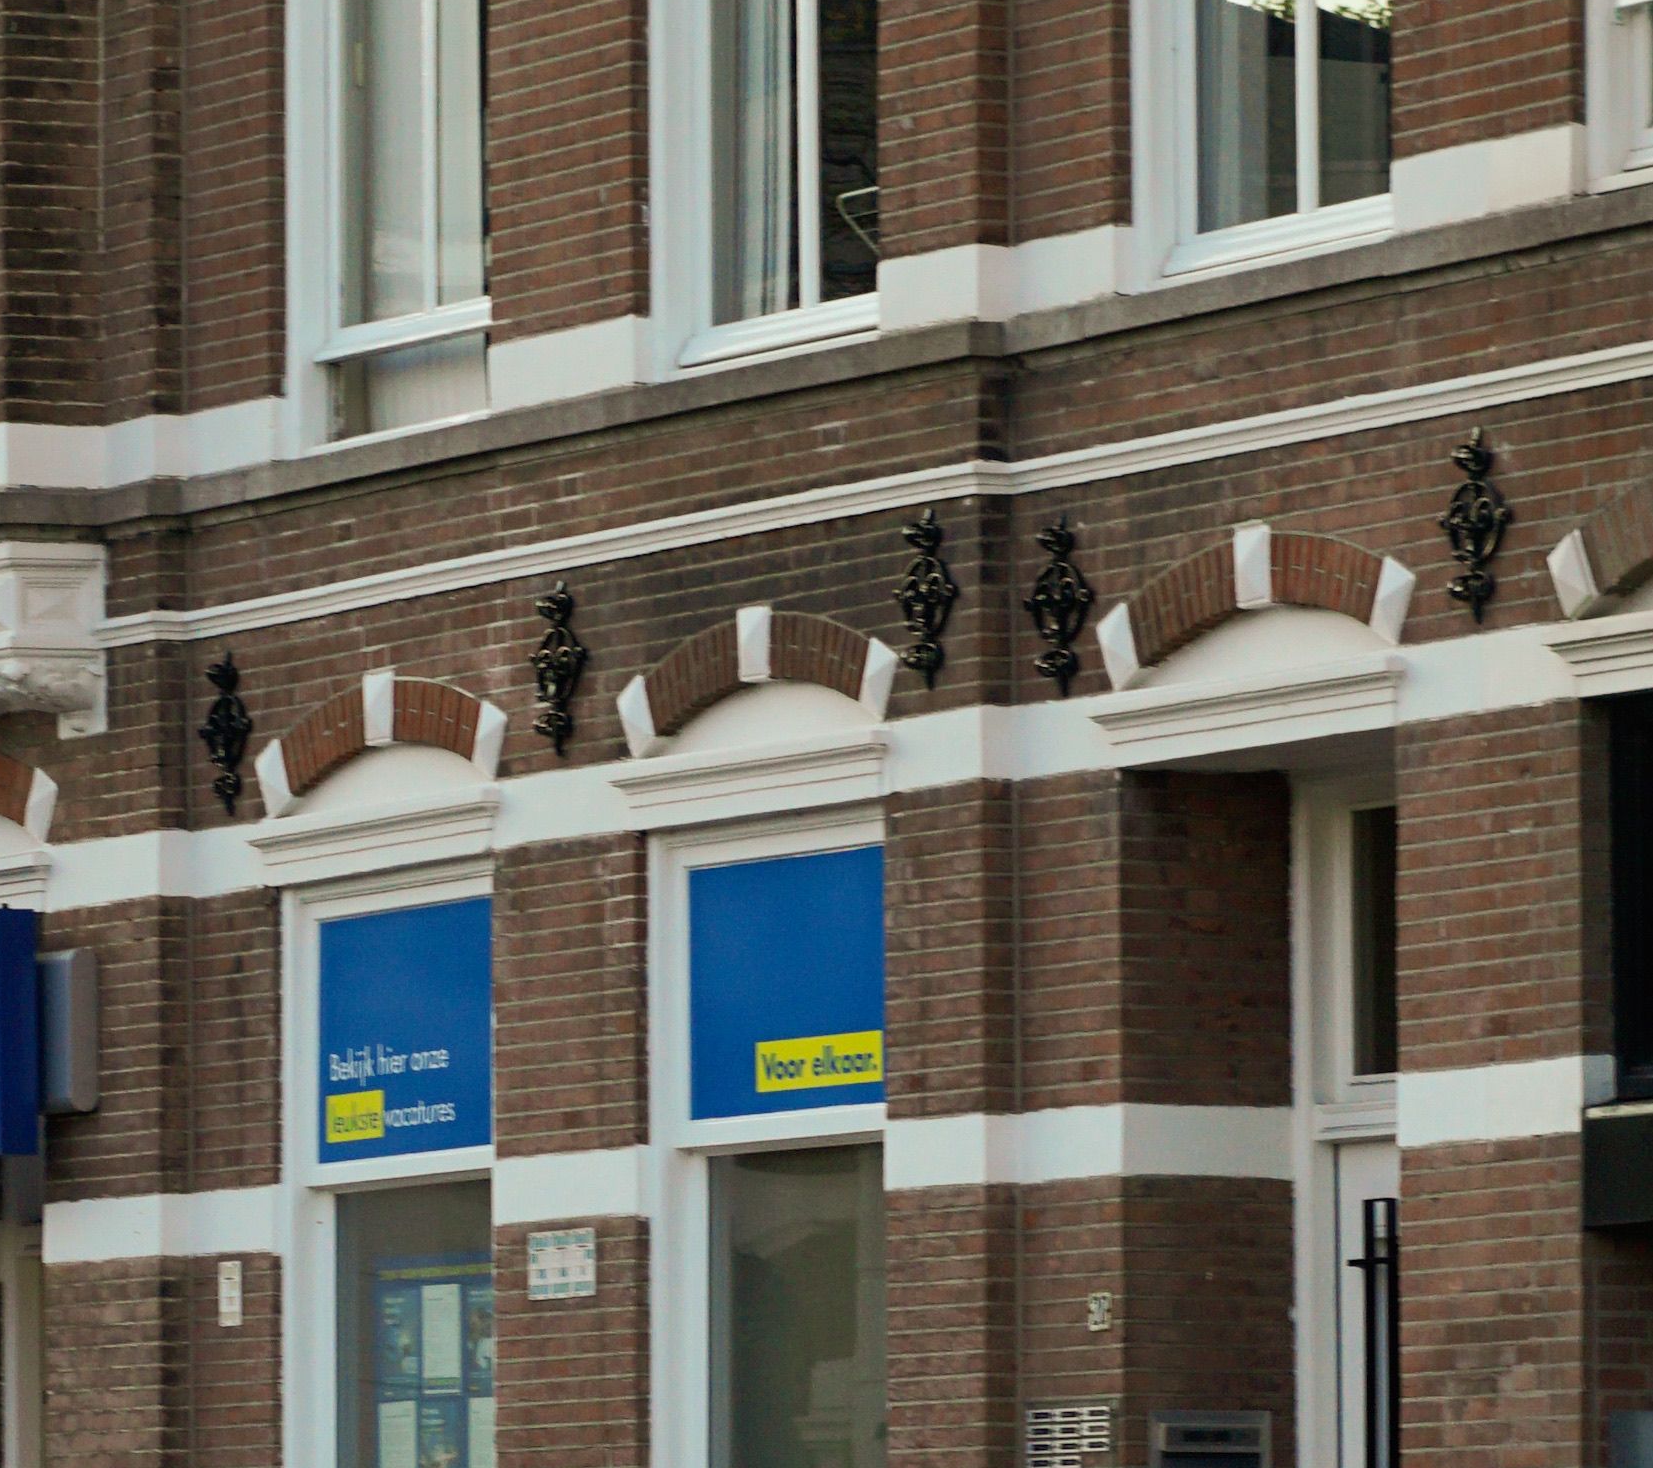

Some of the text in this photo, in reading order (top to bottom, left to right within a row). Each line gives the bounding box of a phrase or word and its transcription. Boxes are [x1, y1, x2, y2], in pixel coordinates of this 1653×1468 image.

[329, 1043, 450, 1087] Bekijk hier onze
[761, 1044, 878, 1081] Voor elkaar.
[330, 1100, 456, 1134] leukste vacatures
